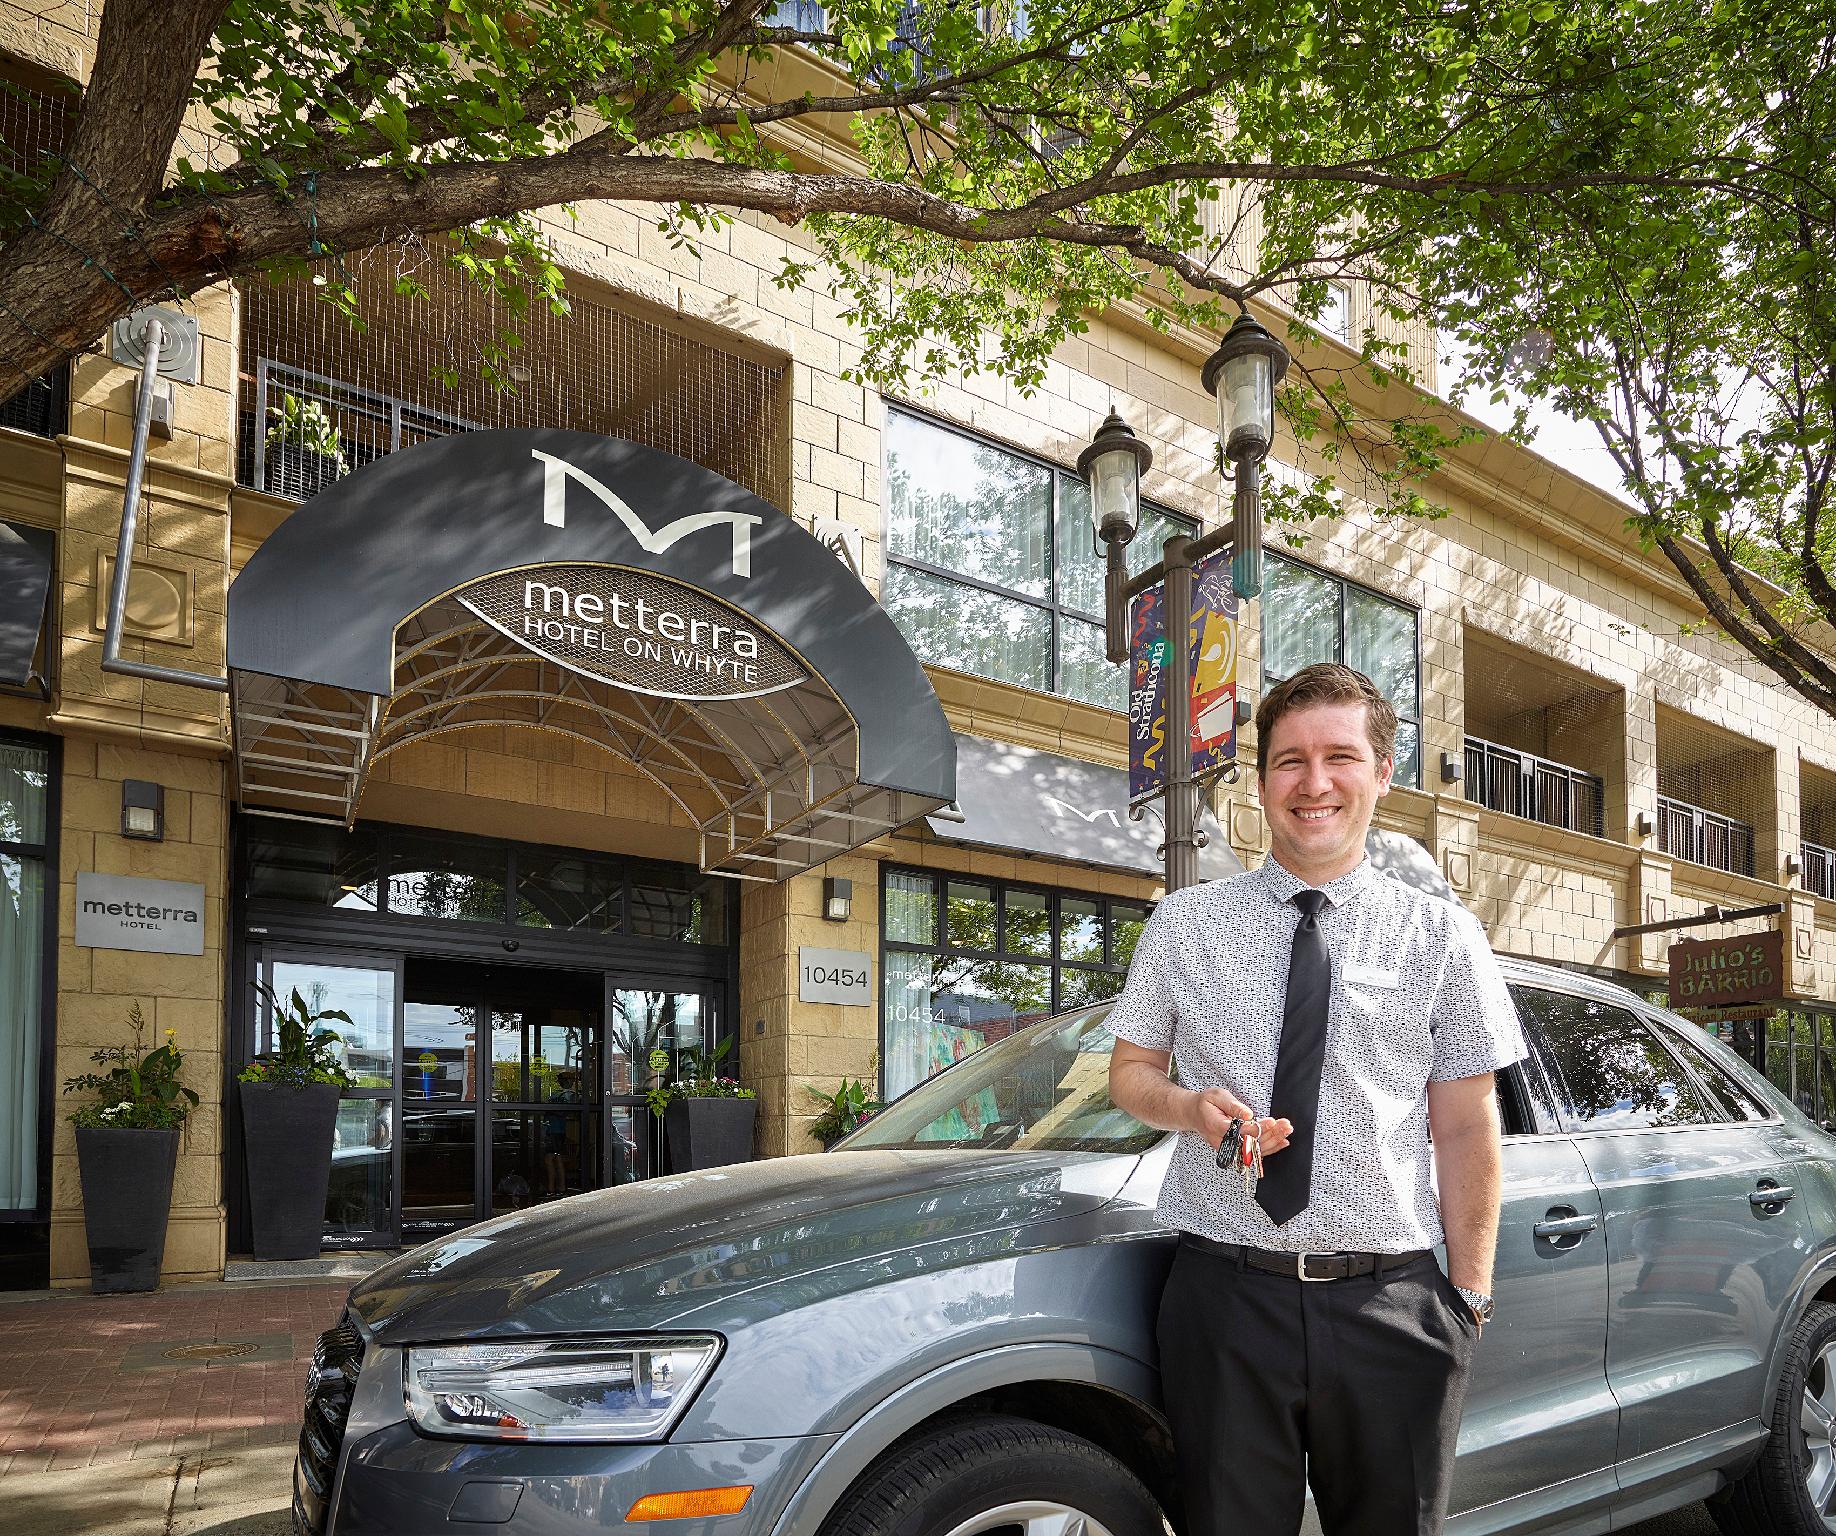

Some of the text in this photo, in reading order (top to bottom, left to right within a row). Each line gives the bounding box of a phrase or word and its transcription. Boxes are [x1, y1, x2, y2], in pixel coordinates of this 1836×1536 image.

[524, 580, 758, 659] metterra
[524, 615, 758, 684] HOTEL ON WHYTE
[1130, 689, 1143, 723] Old
[1136, 642, 1165, 740] Strathcona
[83, 900, 198, 923] metterra
[120, 920, 162, 931] HOTEL
[1680, 944, 1765, 975] Julio's
[804, 965, 867, 988] 10454
[1679, 966, 1774, 997] BARRIO
[887, 1004, 946, 1025] 10454
[1721, 1007, 1775, 1021] Restaurant
